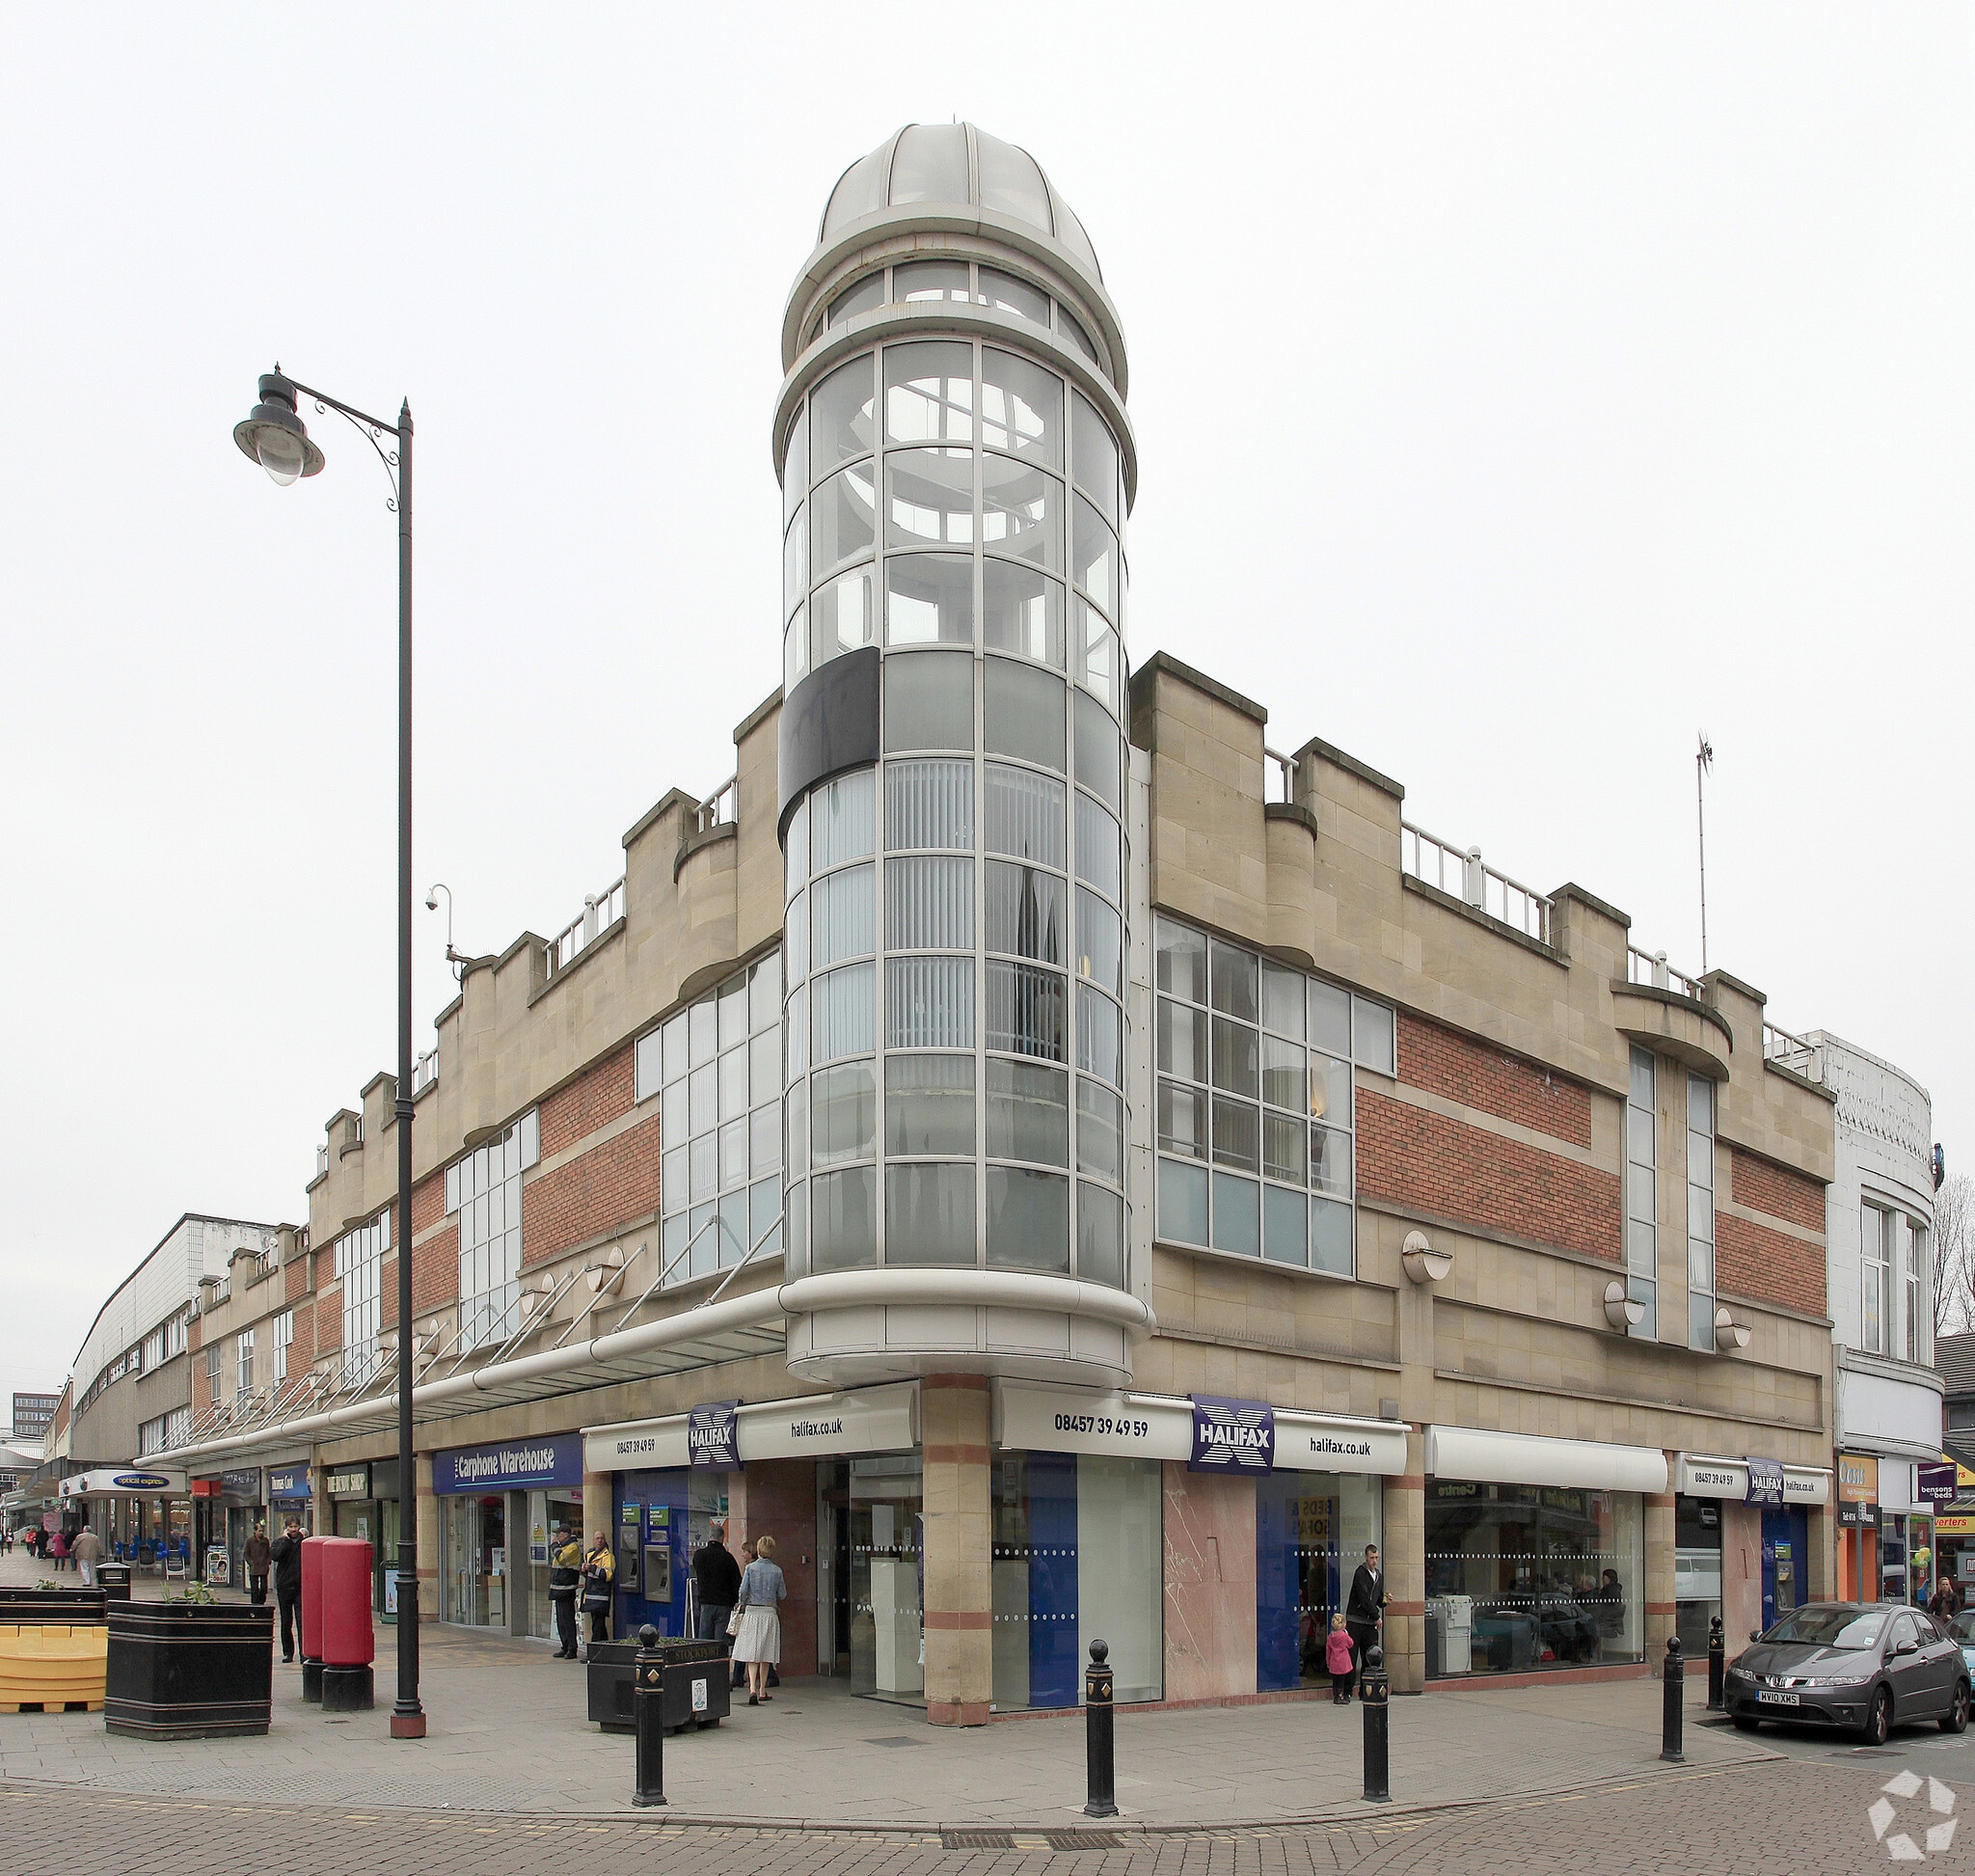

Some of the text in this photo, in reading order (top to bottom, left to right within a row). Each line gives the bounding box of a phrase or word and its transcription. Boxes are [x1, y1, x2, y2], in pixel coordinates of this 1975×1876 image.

[791, 1418, 843, 1437] halifax.co.uk
[1054, 1413, 1149, 1437] 08457 39 49 59
[690, 1427, 732, 1448] HALIFAX
[1199, 1423, 1270, 1449] HALIFAX
[616, 1438, 655, 1454] 08457 39 49 59
[1310, 1437, 1371, 1456] halifax.co.uk
[458, 1453, 499, 1482] Carphone
[500, 1447, 555, 1474] Warehouse
[1839, 1461, 1866, 1485] Oasis
[271, 1476, 284, 1490] Thomas
[284, 1475, 294, 1489] Cook
[350, 1473, 365, 1491] SHOP
[1694, 1472, 1734, 1485] 08457 39 49 59
[1751, 1475, 1782, 1491] HALIFAX
[1785, 1481, 1815, 1492] halifax.co.uk
[675, 1645, 720, 1660] STOCKPORT
[1761, 1692, 1797, 1703] MV10 XMS
